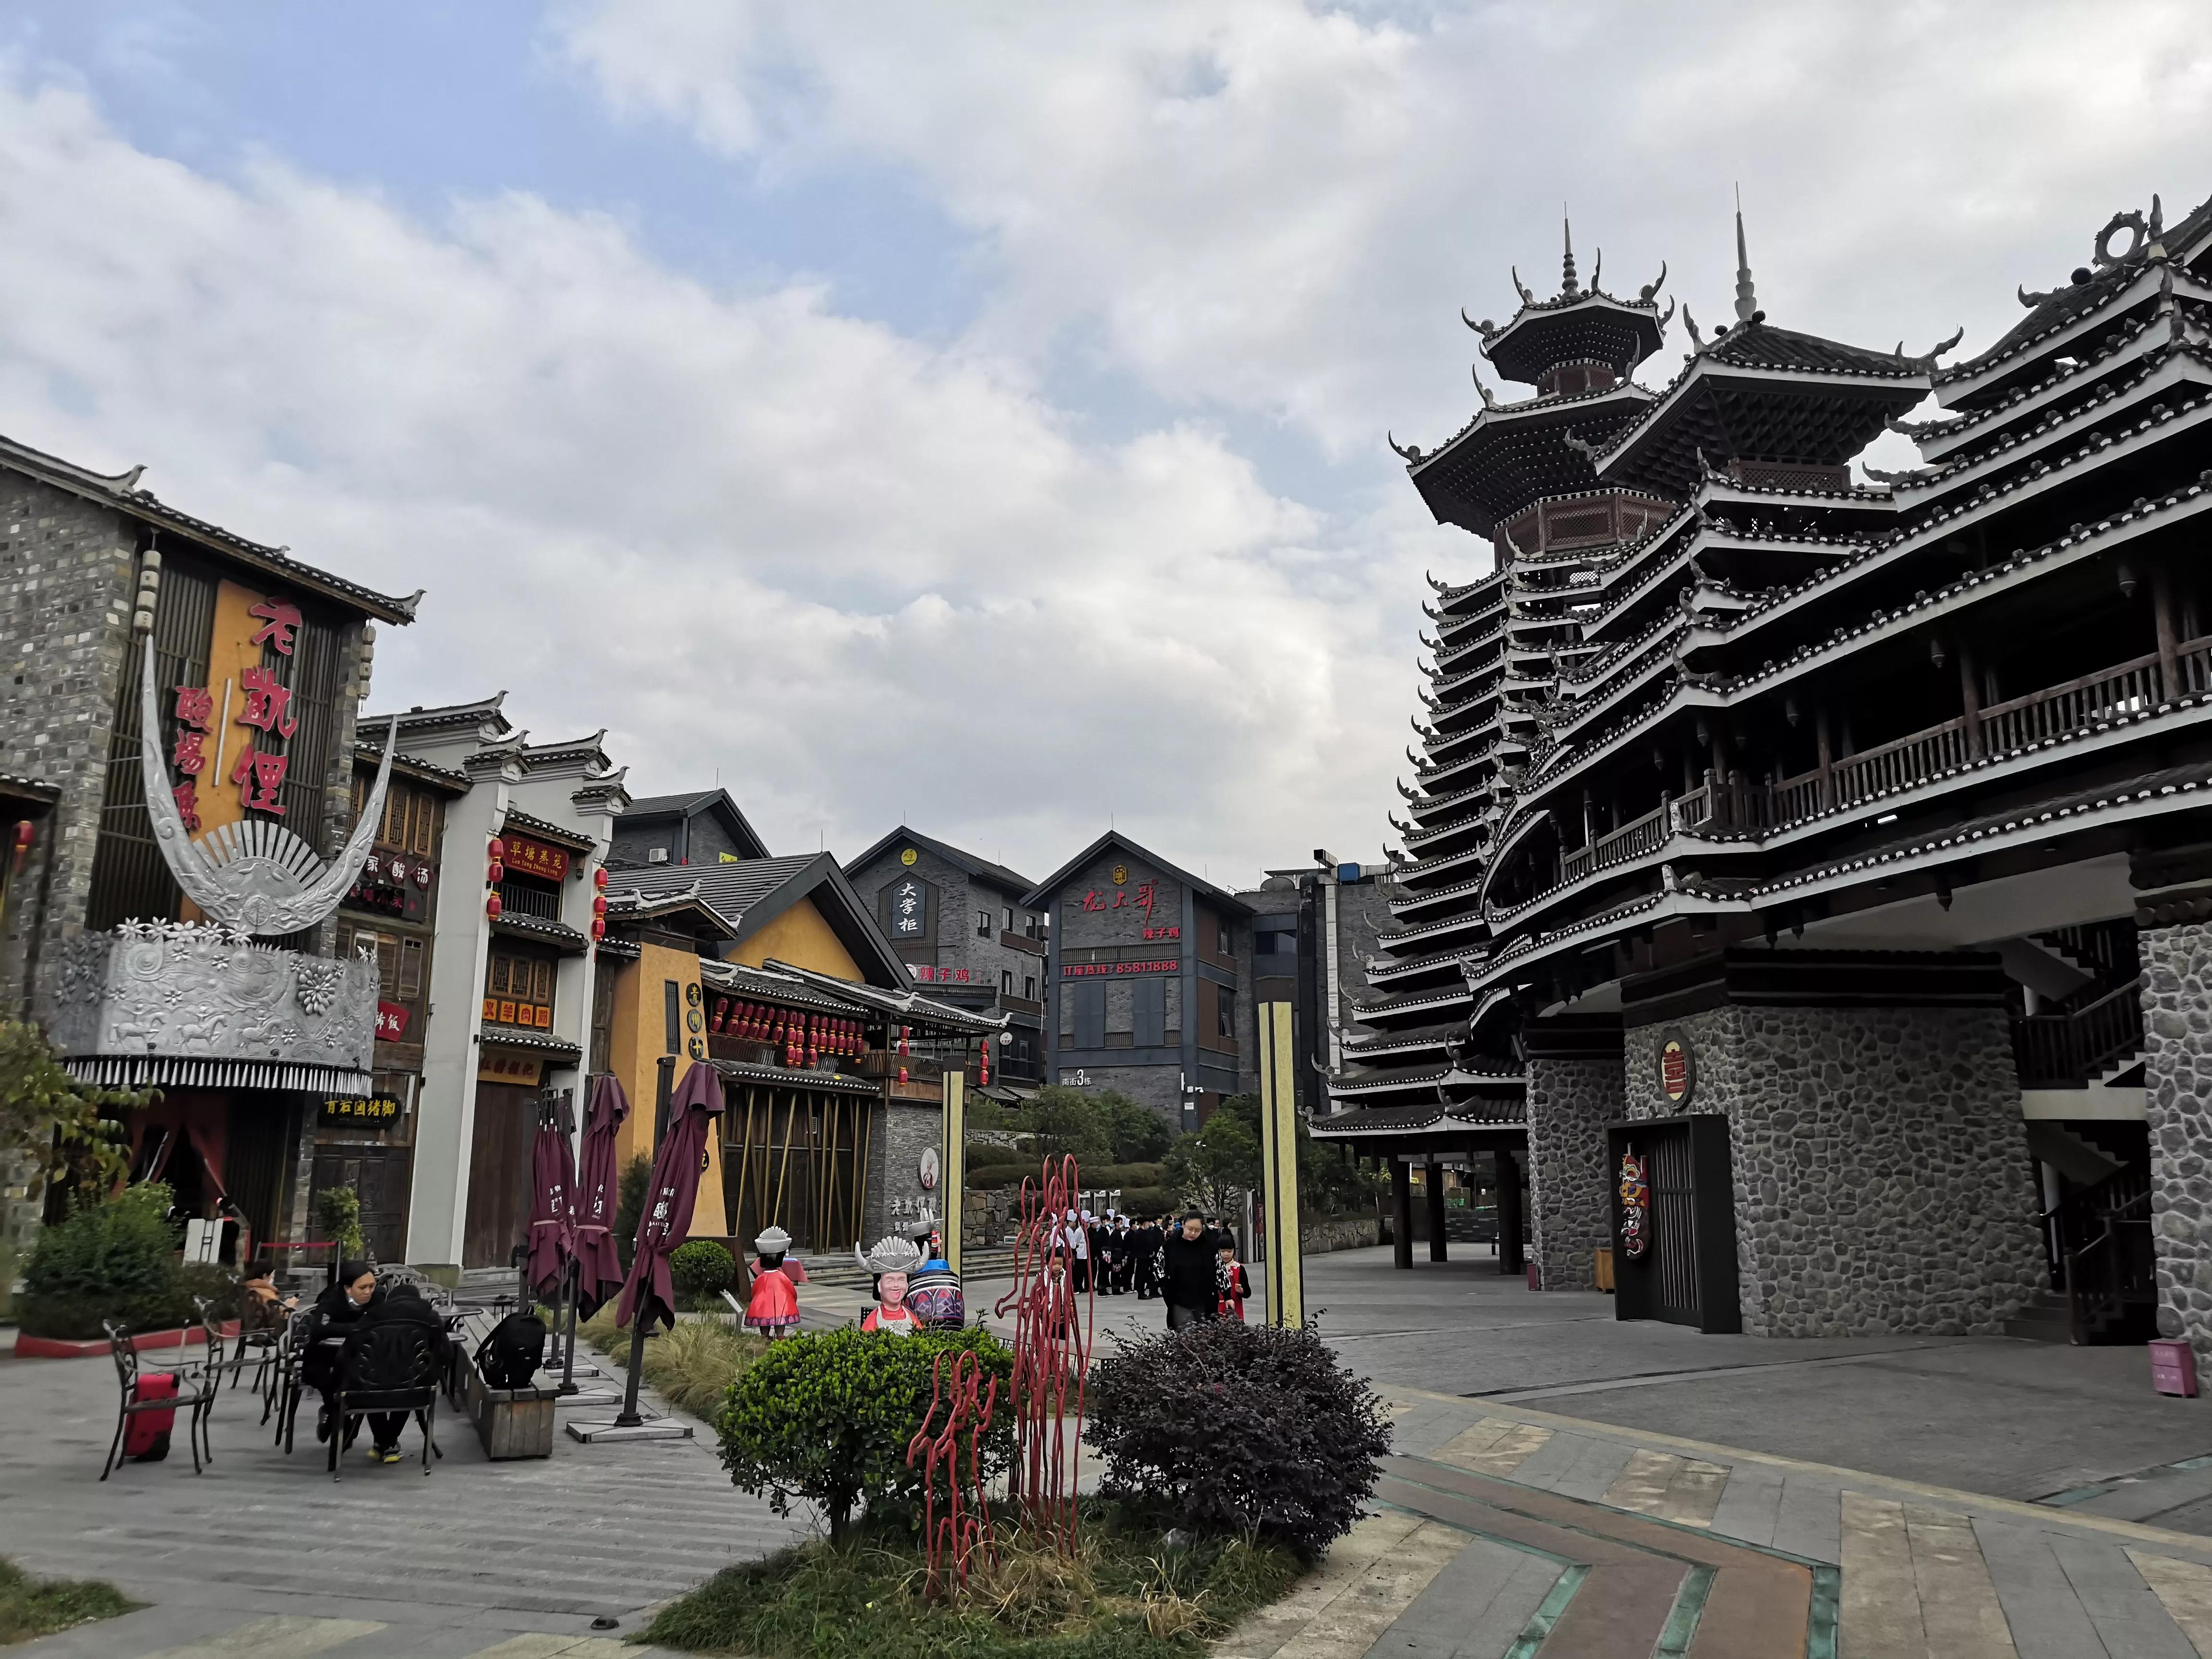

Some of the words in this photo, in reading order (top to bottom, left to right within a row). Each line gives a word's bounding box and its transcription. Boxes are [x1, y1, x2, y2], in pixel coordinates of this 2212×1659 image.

[510, 841, 562, 869] 草塘蒸笼
[898, 883, 918, 932] 大掌柜
[1142, 927, 1180, 940] 辣子鸡
[920, 965, 970, 983] 辣子鸡
[1062, 1069, 1092, 1086] 南街3栋
